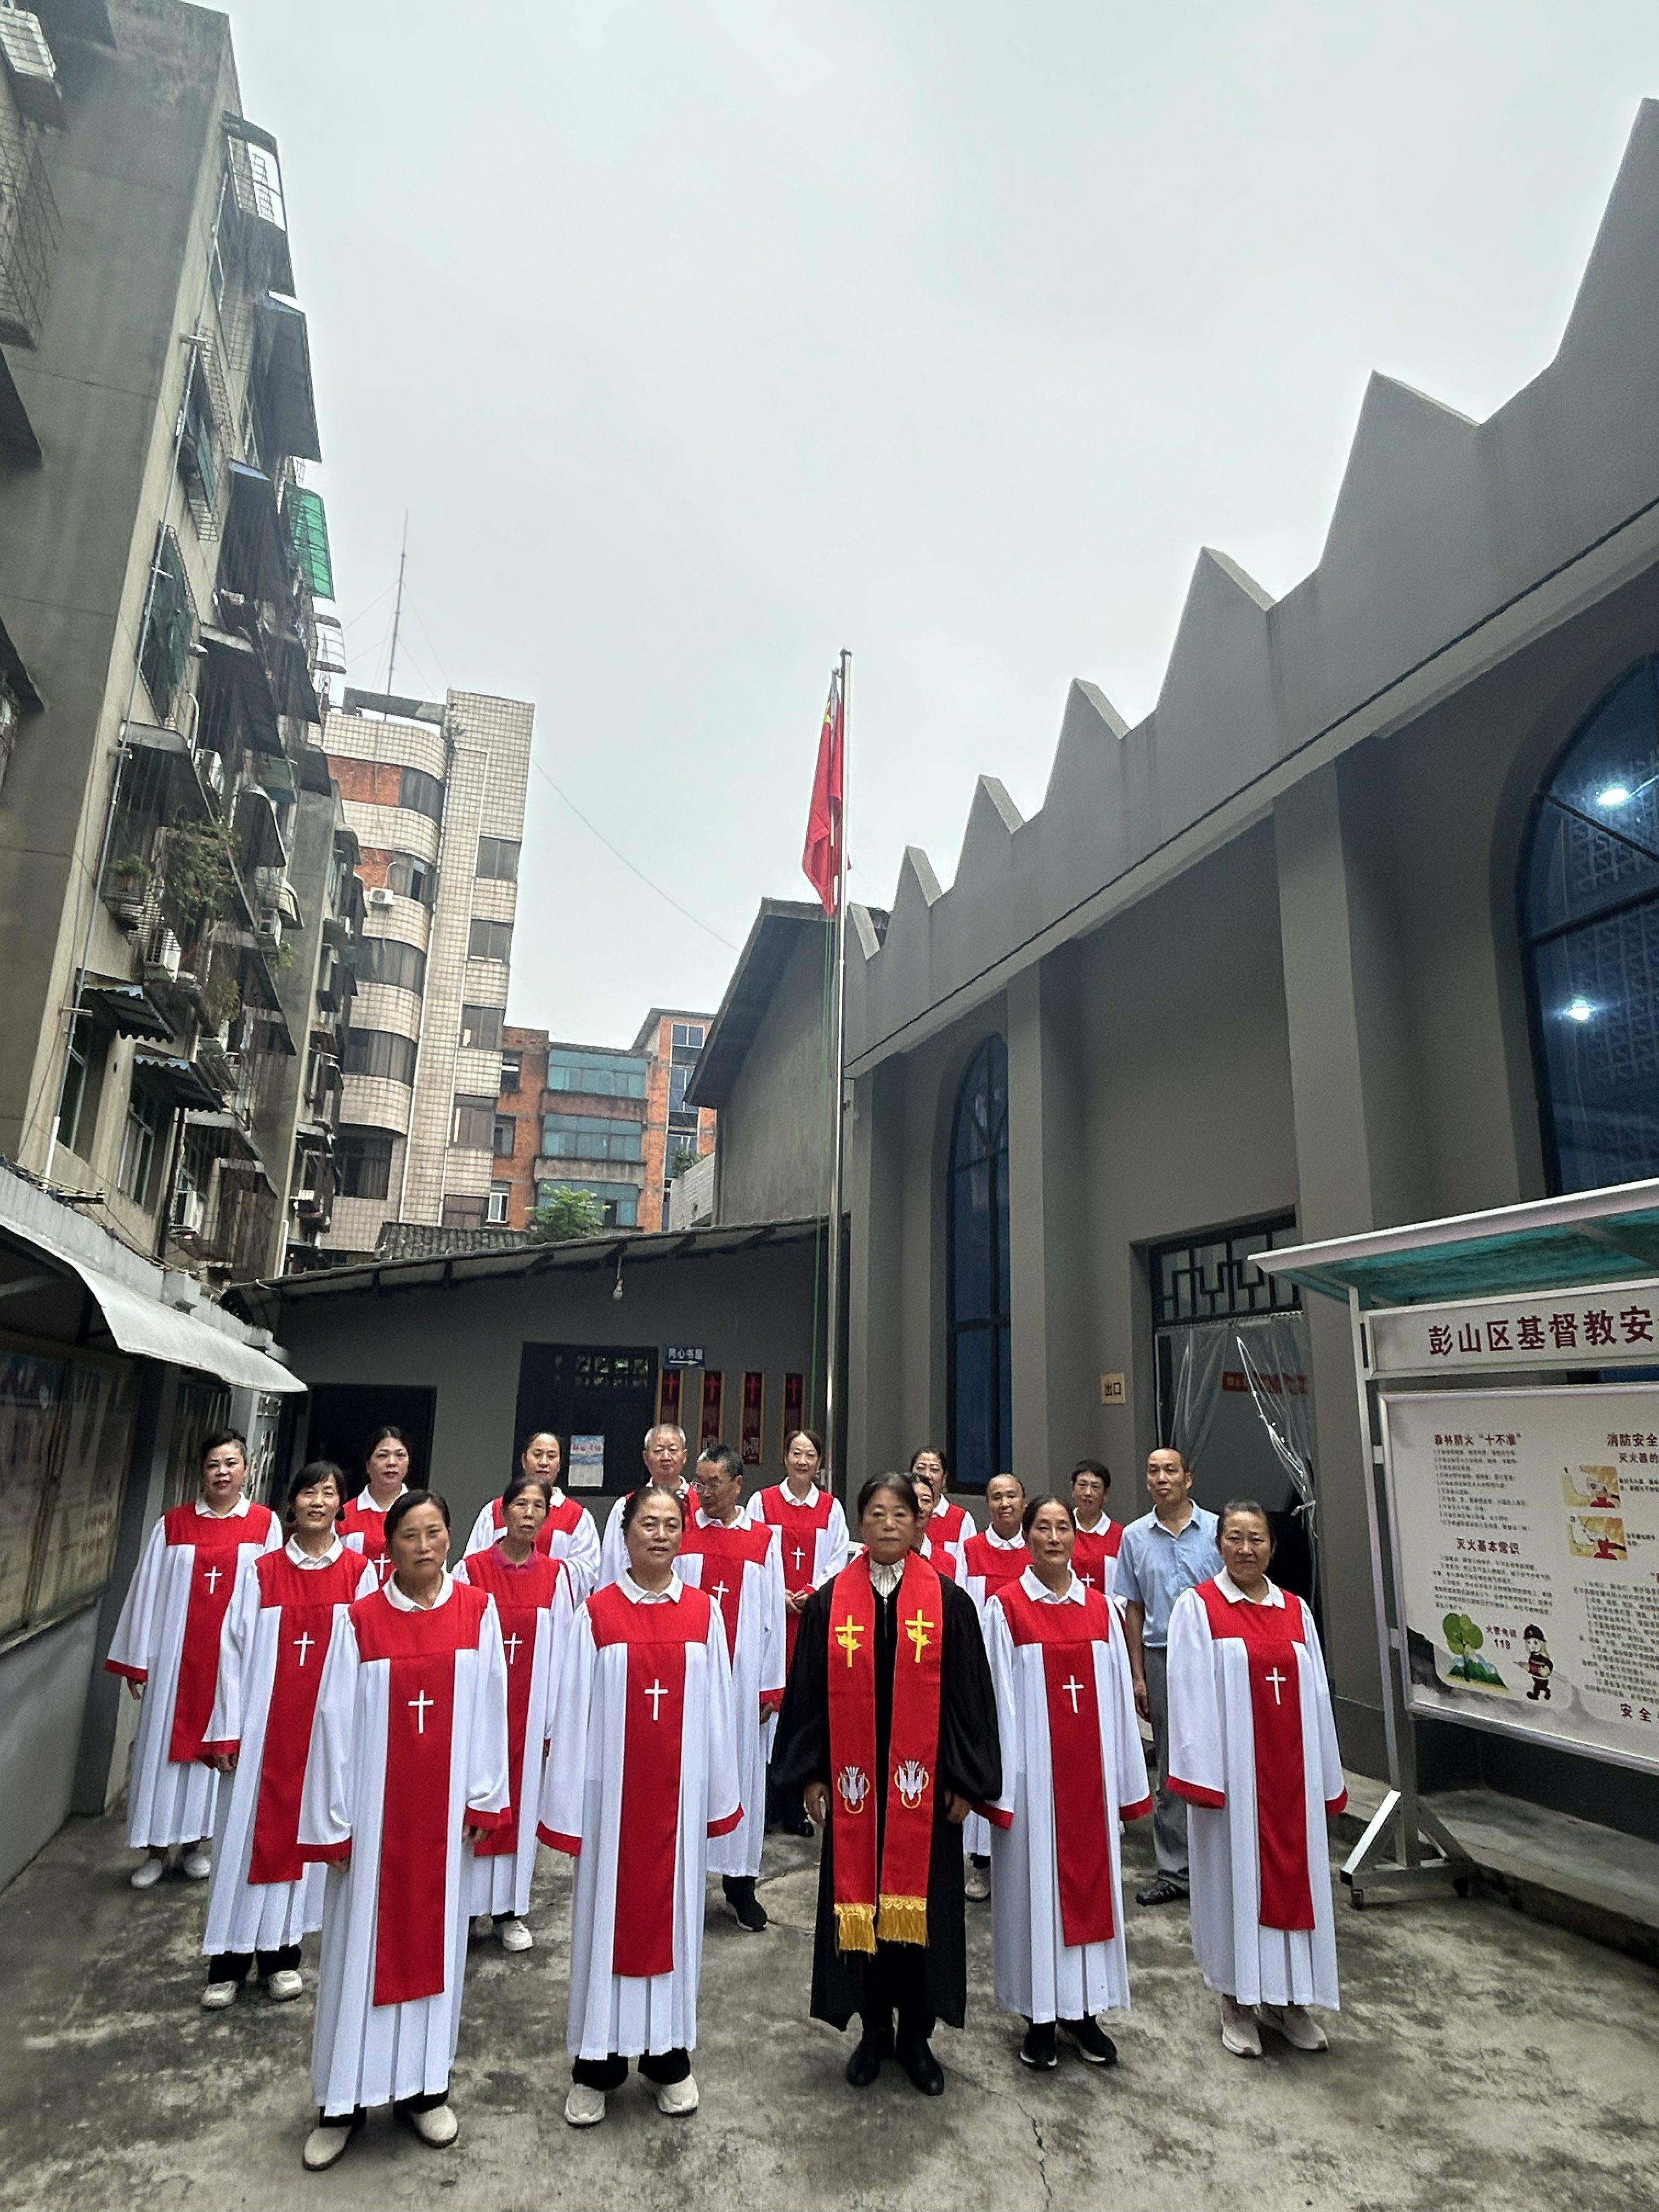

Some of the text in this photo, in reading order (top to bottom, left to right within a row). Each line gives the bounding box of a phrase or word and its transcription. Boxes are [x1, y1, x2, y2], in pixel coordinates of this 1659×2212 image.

[1429, 1306, 1654, 1356] 彭山区基督教安
[1105, 1381, 1121, 1397] 出口
[1606, 1432, 1658, 1447] 消防安全
[1456, 1537, 1520, 1555] 灭火基本常识
[1494, 1638, 1510, 1650] 119
